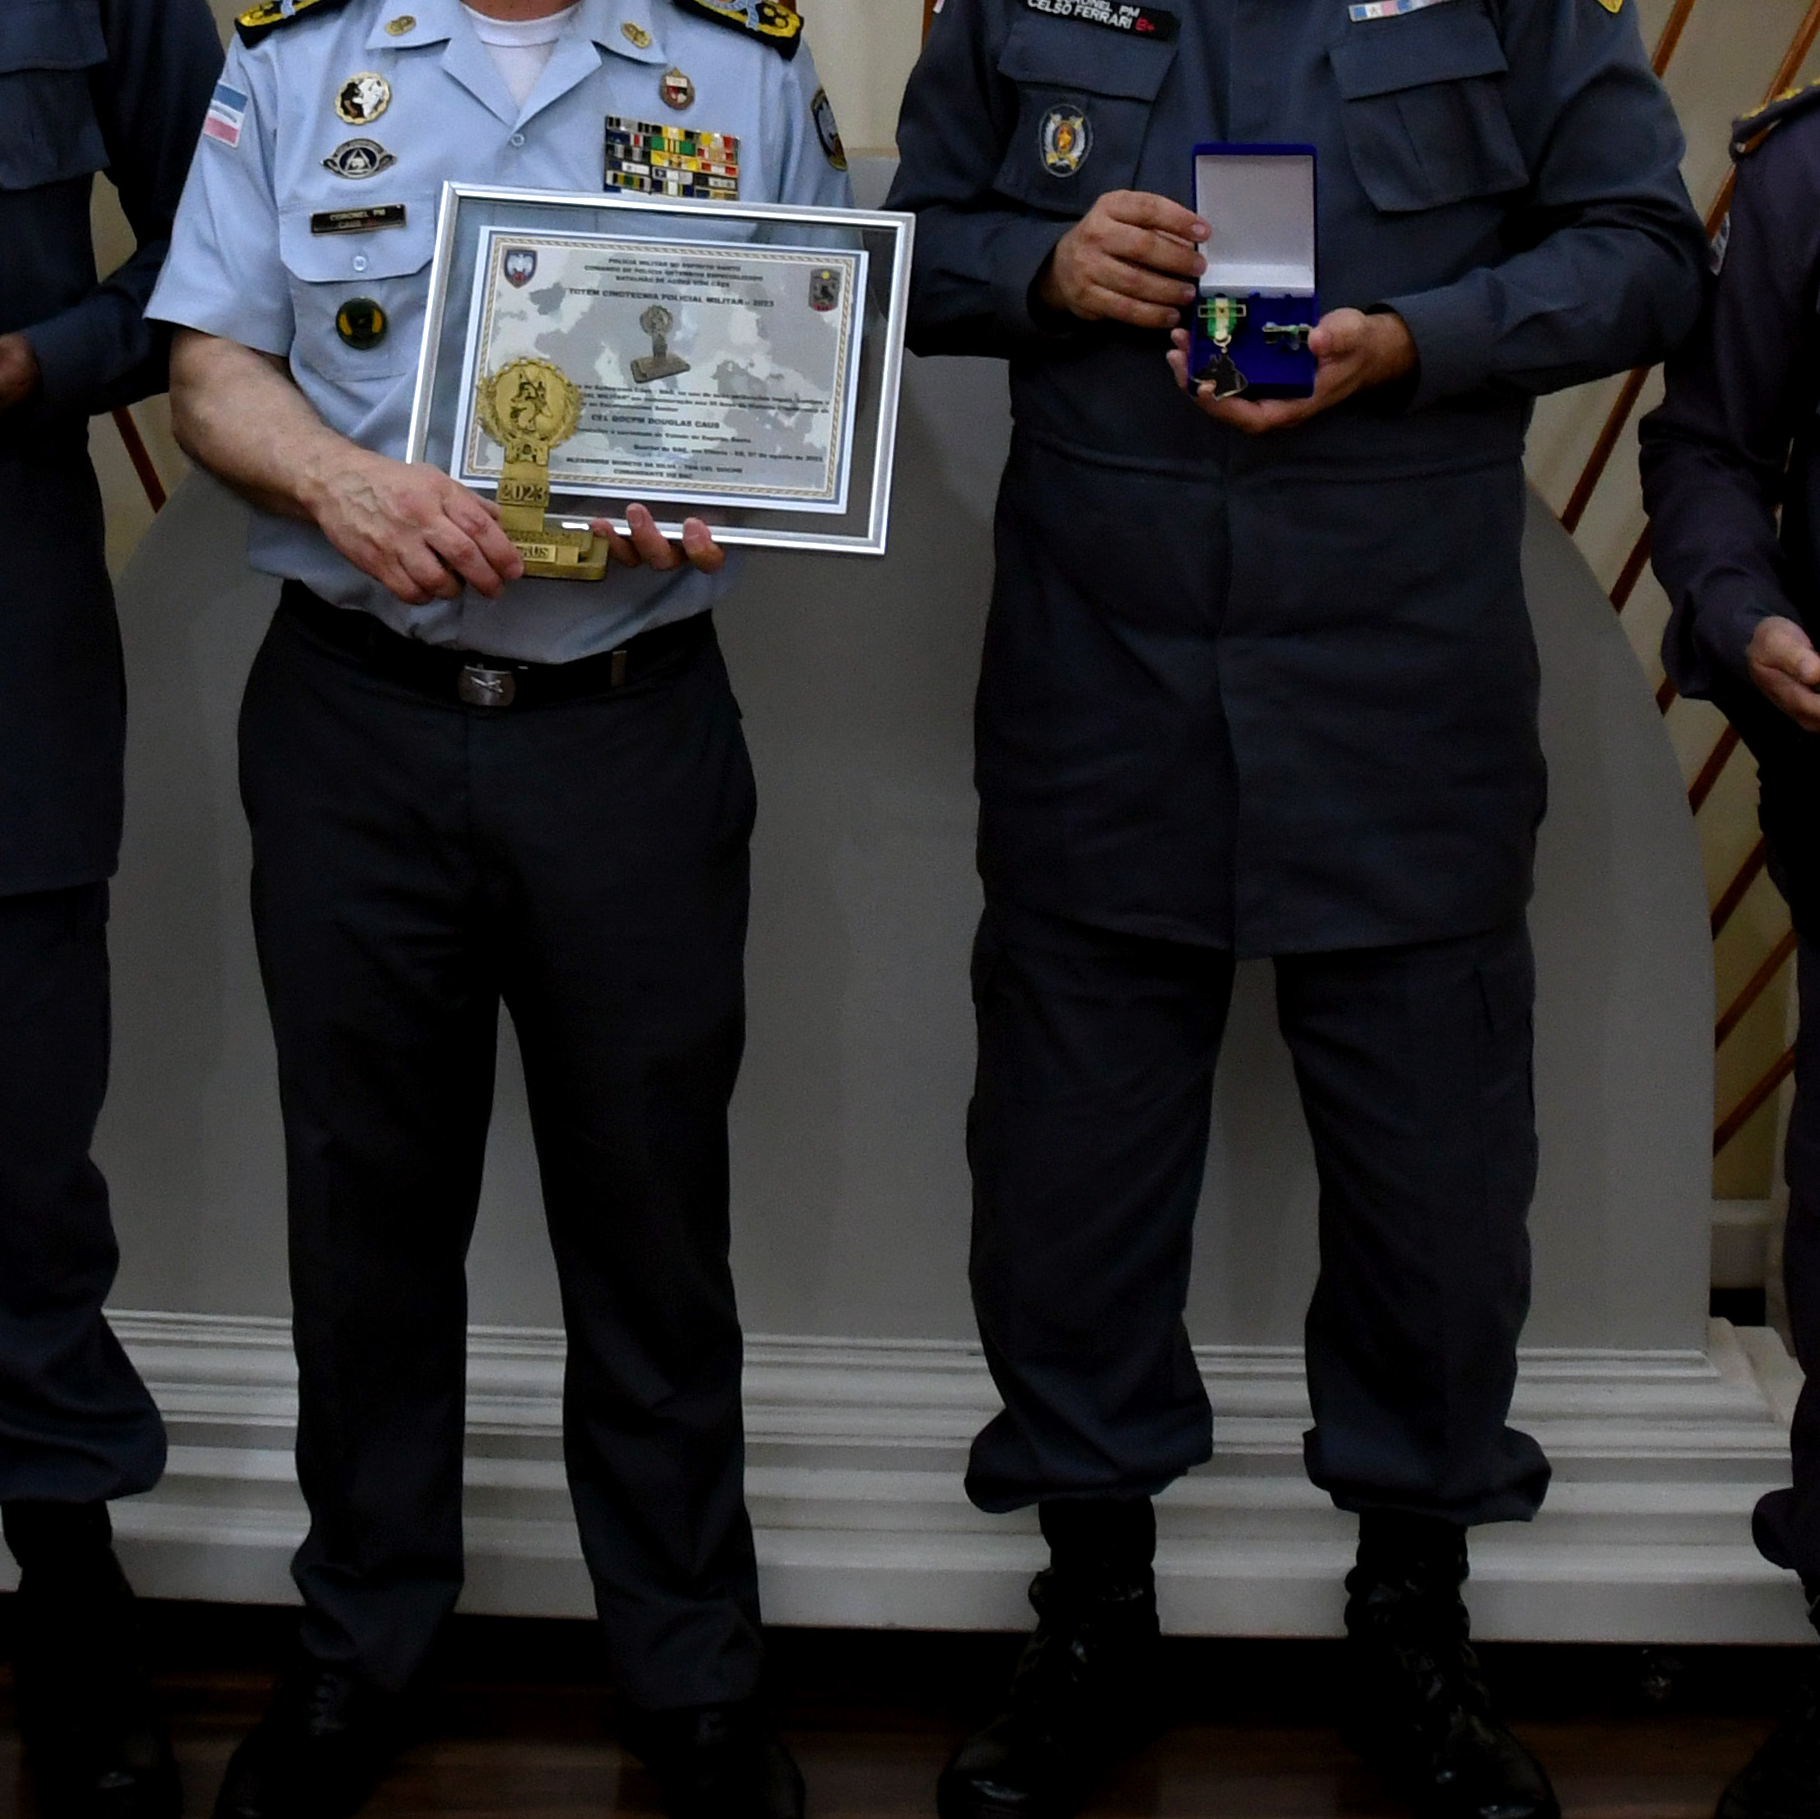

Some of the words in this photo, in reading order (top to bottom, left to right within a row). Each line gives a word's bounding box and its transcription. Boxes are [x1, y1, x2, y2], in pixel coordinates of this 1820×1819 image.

[1073, 5, 1133, 30] FERRARI
[1119, 5, 1140, 18] PM
[648, 417, 691, 427] DOUGLAS
[695, 421, 719, 429] CAUS
[501, 483, 546, 503] 2023
